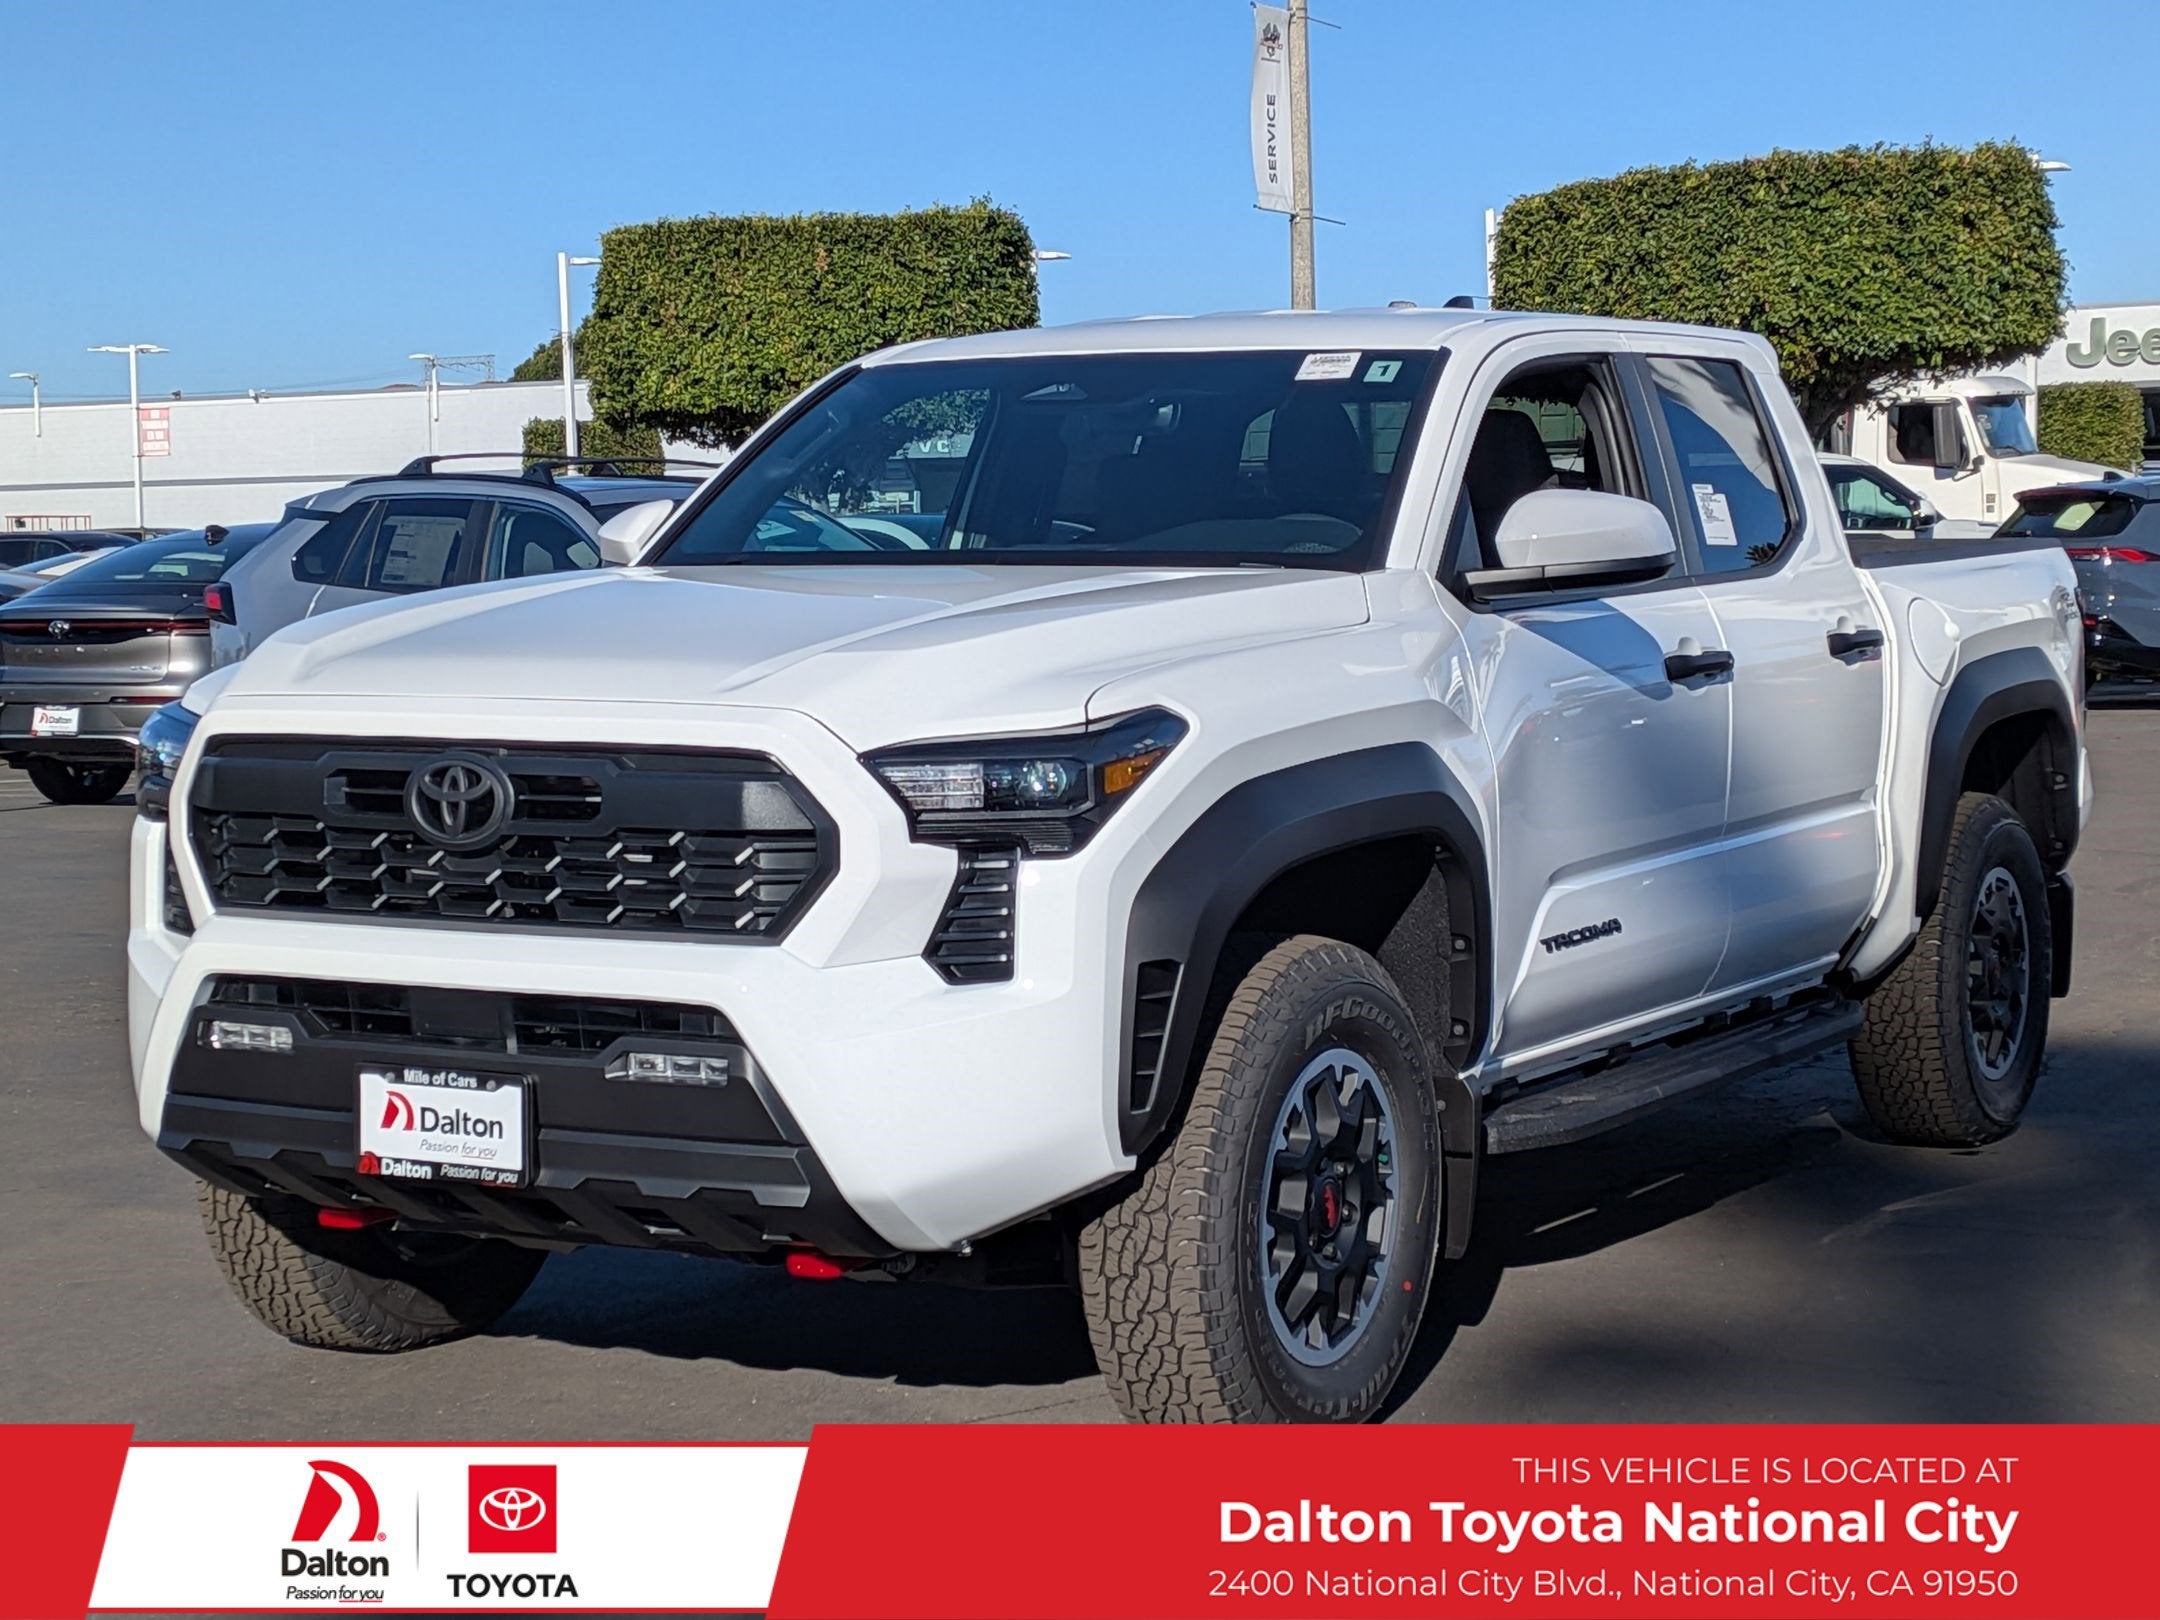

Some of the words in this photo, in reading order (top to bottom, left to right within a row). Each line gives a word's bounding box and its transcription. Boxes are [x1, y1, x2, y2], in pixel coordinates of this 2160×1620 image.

[1266, 93, 1278, 185] SERVICE
[1378, 363, 1392, 377] 1
[1539, 917, 1622, 953] TACOMA
[403, 1067, 430, 1084] Mile
[432, 1071, 445, 1086] of
[447, 1072, 478, 1089] Cars
[419, 1106, 504, 1139] Dalton
[419, 1138, 459, 1154] Passion
[461, 1141, 477, 1155] for
[477, 1146, 498, 1158] you
[380, 1157, 432, 1180] Dalton
[440, 1164, 480, 1180] Passion
[481, 1167, 496, 1181] for
[495, 1171, 519, 1185] you
